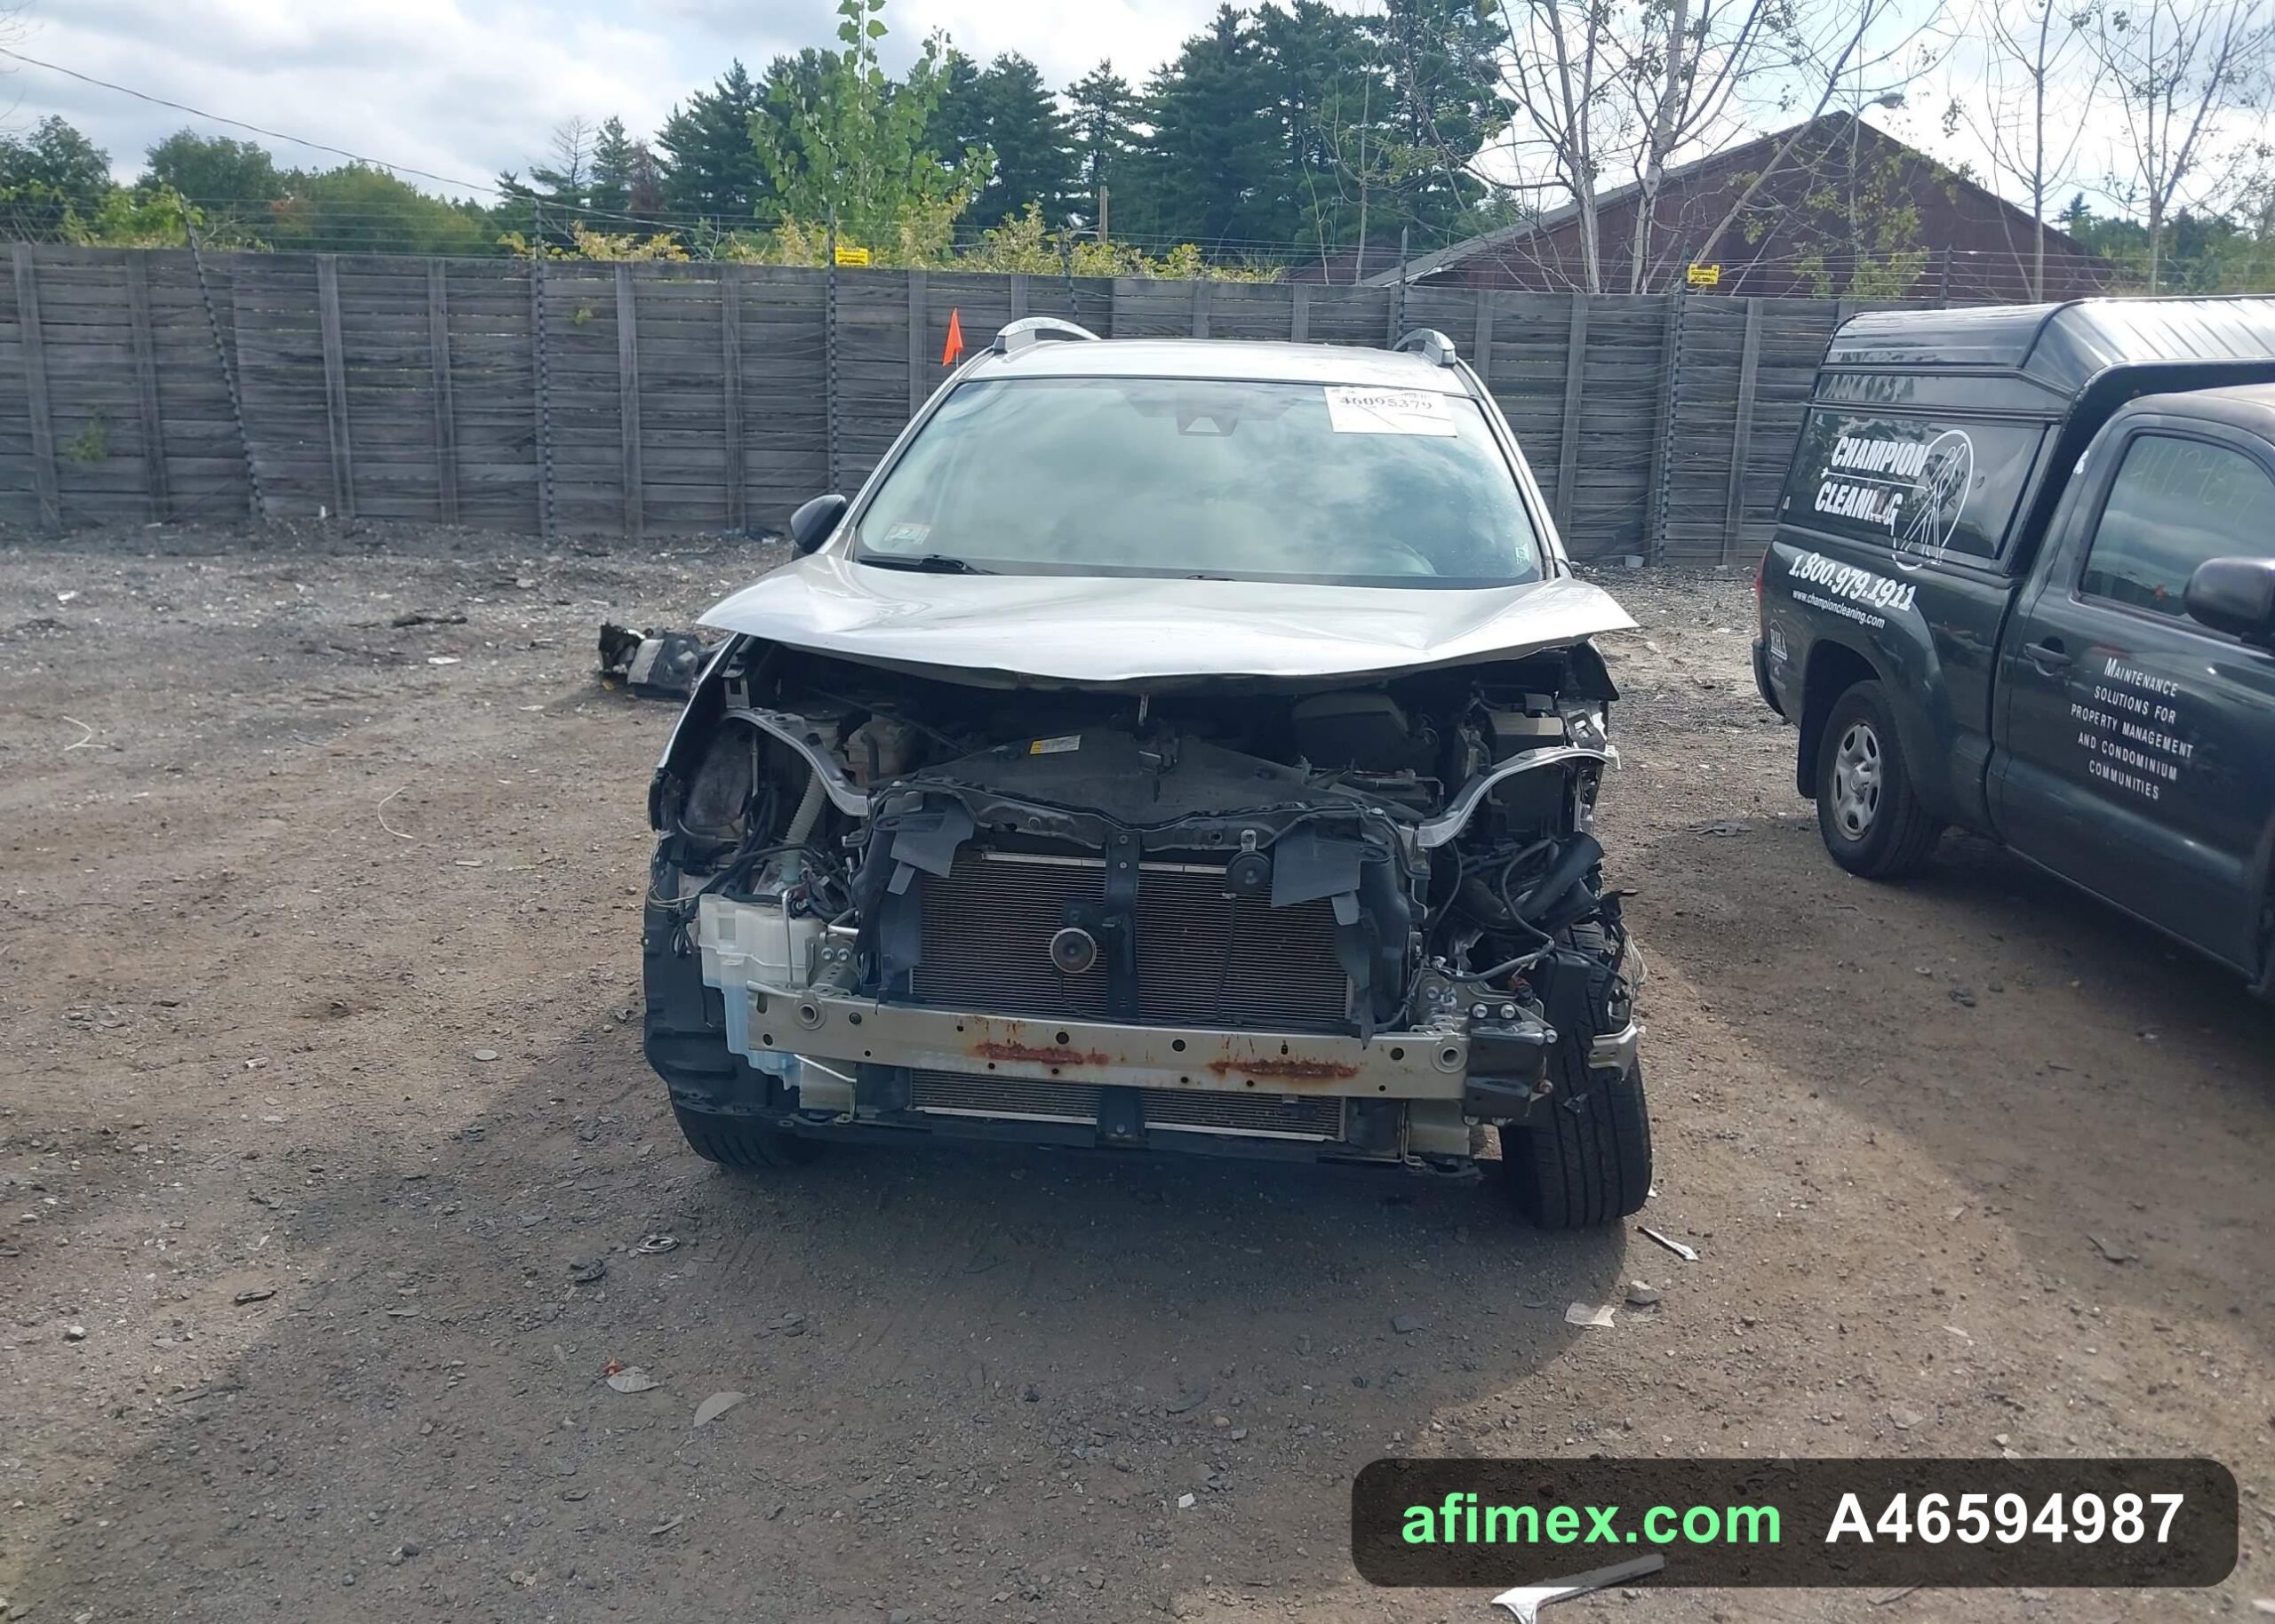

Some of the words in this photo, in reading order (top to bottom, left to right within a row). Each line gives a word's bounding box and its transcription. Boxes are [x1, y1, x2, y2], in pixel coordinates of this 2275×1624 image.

[1831, 436, 1929, 477] CHAMPION
[1815, 481, 1903, 530] CLEANIG
[1788, 552, 1917, 612] 1.800.979.1911
[1792, 588, 1886, 630] www.championcleaning.com
[2094, 685, 2149, 716] SOLUTIONS
[2154, 705, 2176, 724] FOR
[2071, 703, 2118, 731] PROPERTY
[2121, 721, 2194, 759] MANAGEMENT
[2078, 732, 2096, 749] AND
[2101, 740, 2178, 781] CONDOMINIUM
[2088, 760, 2159, 800] COMMUNITIES
